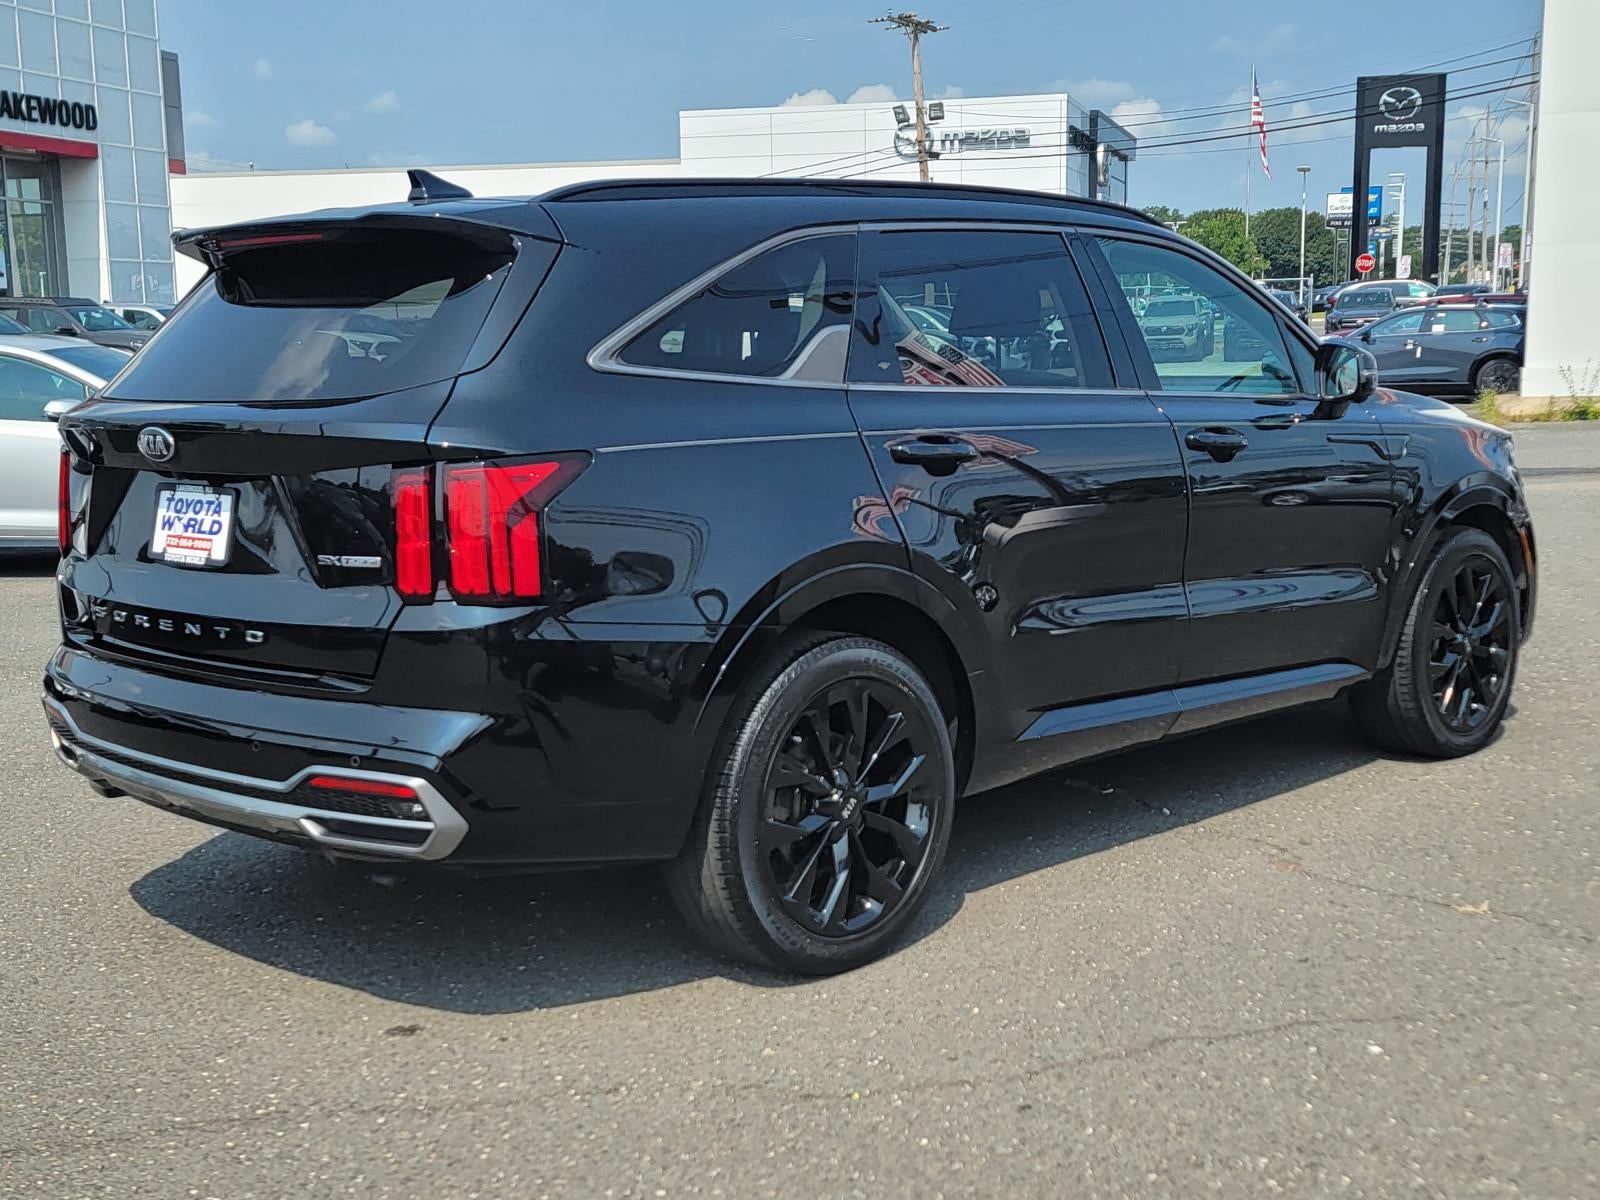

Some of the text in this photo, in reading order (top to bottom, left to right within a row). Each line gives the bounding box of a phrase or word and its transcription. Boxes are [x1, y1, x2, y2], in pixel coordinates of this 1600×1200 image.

[1357, 259, 1375, 267] STOP
[140, 434, 168, 454] KIA
[166, 496, 222, 517] TOYOTA
[317, 554, 341, 566] SX
[96, 604, 265, 643] SORENTO
[842, 797, 857, 819] KIA
